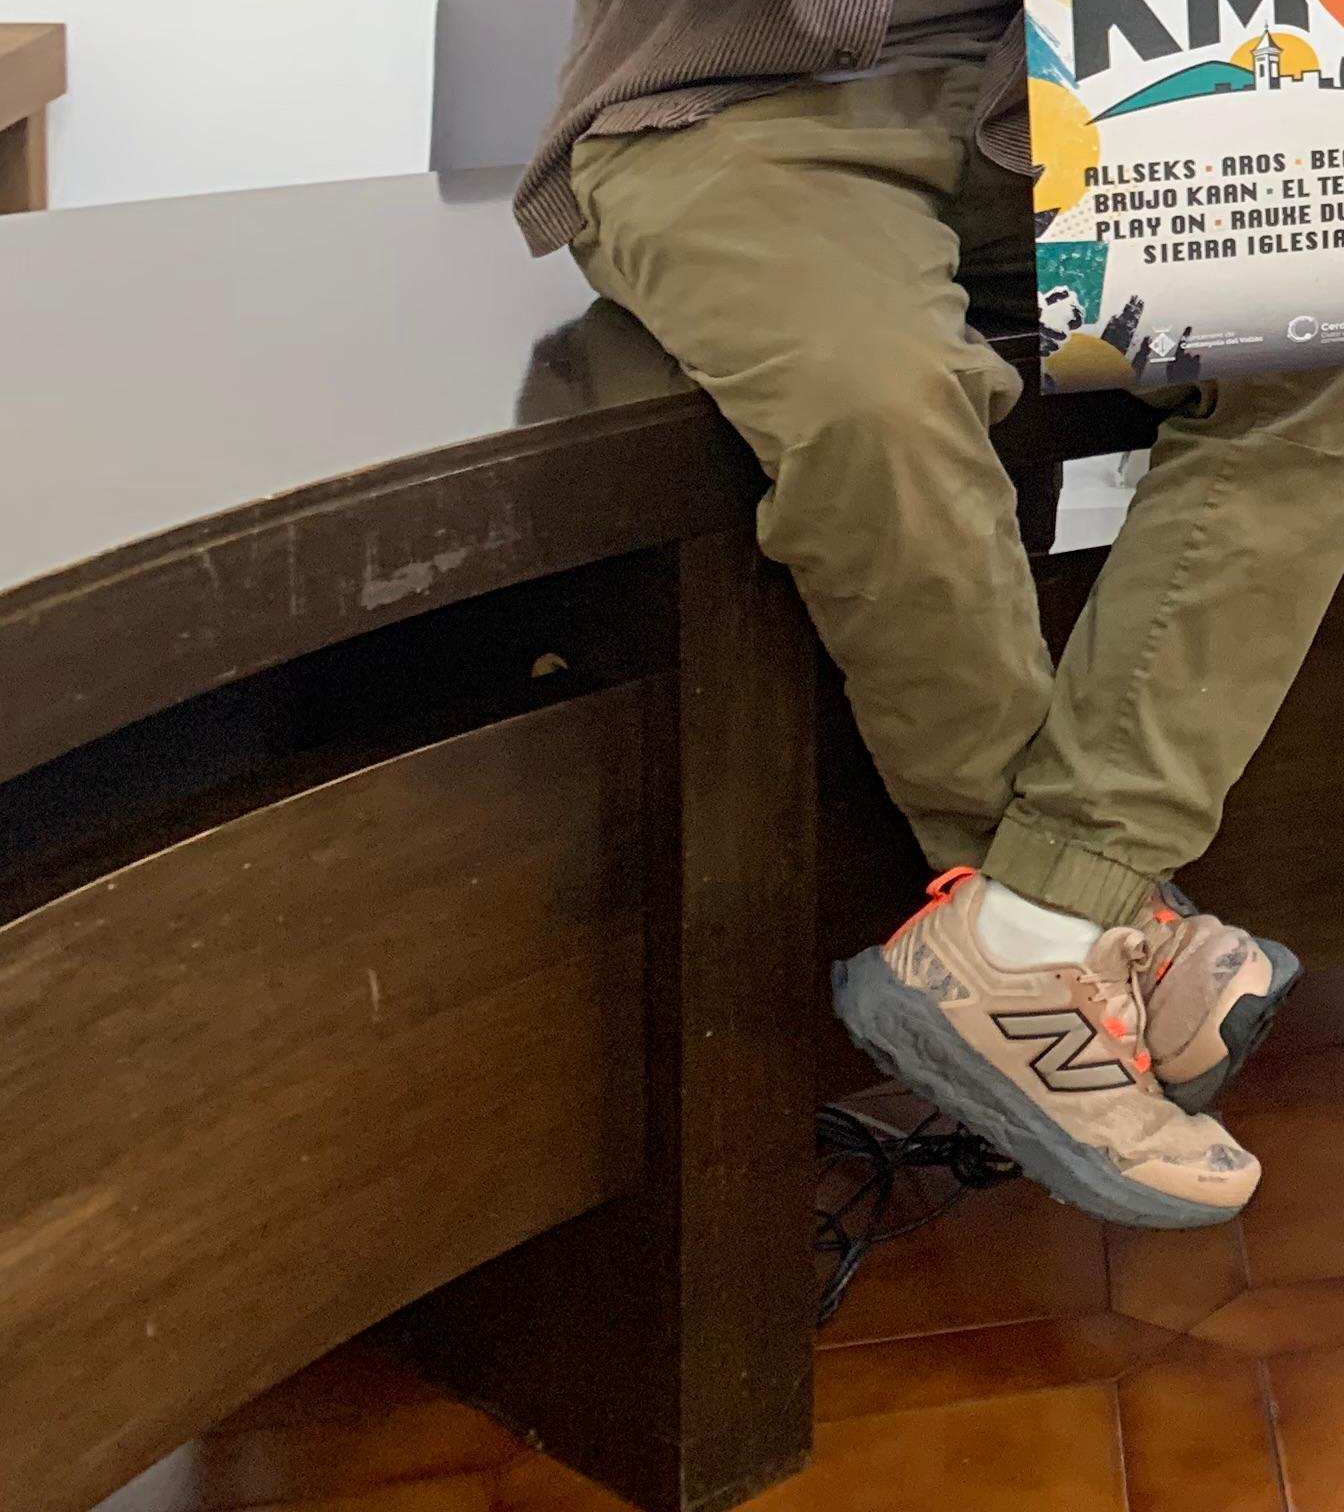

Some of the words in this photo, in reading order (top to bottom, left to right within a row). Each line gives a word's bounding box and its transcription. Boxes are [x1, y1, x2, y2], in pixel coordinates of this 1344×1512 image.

[1084, 160, 1196, 187] ALLSEKS
[1222, 153, 1285, 176] AROS
[1094, 189, 1177, 214] BRUJO
[1187, 182, 1258, 206] KAAN
[1282, 179, 1310, 199] EL
[1096, 217, 1161, 242] PLAY
[1171, 213, 1205, 235] ON
[1231, 205, 1311, 230] RAUXE
[1143, 238, 1236, 264] SIERRA
